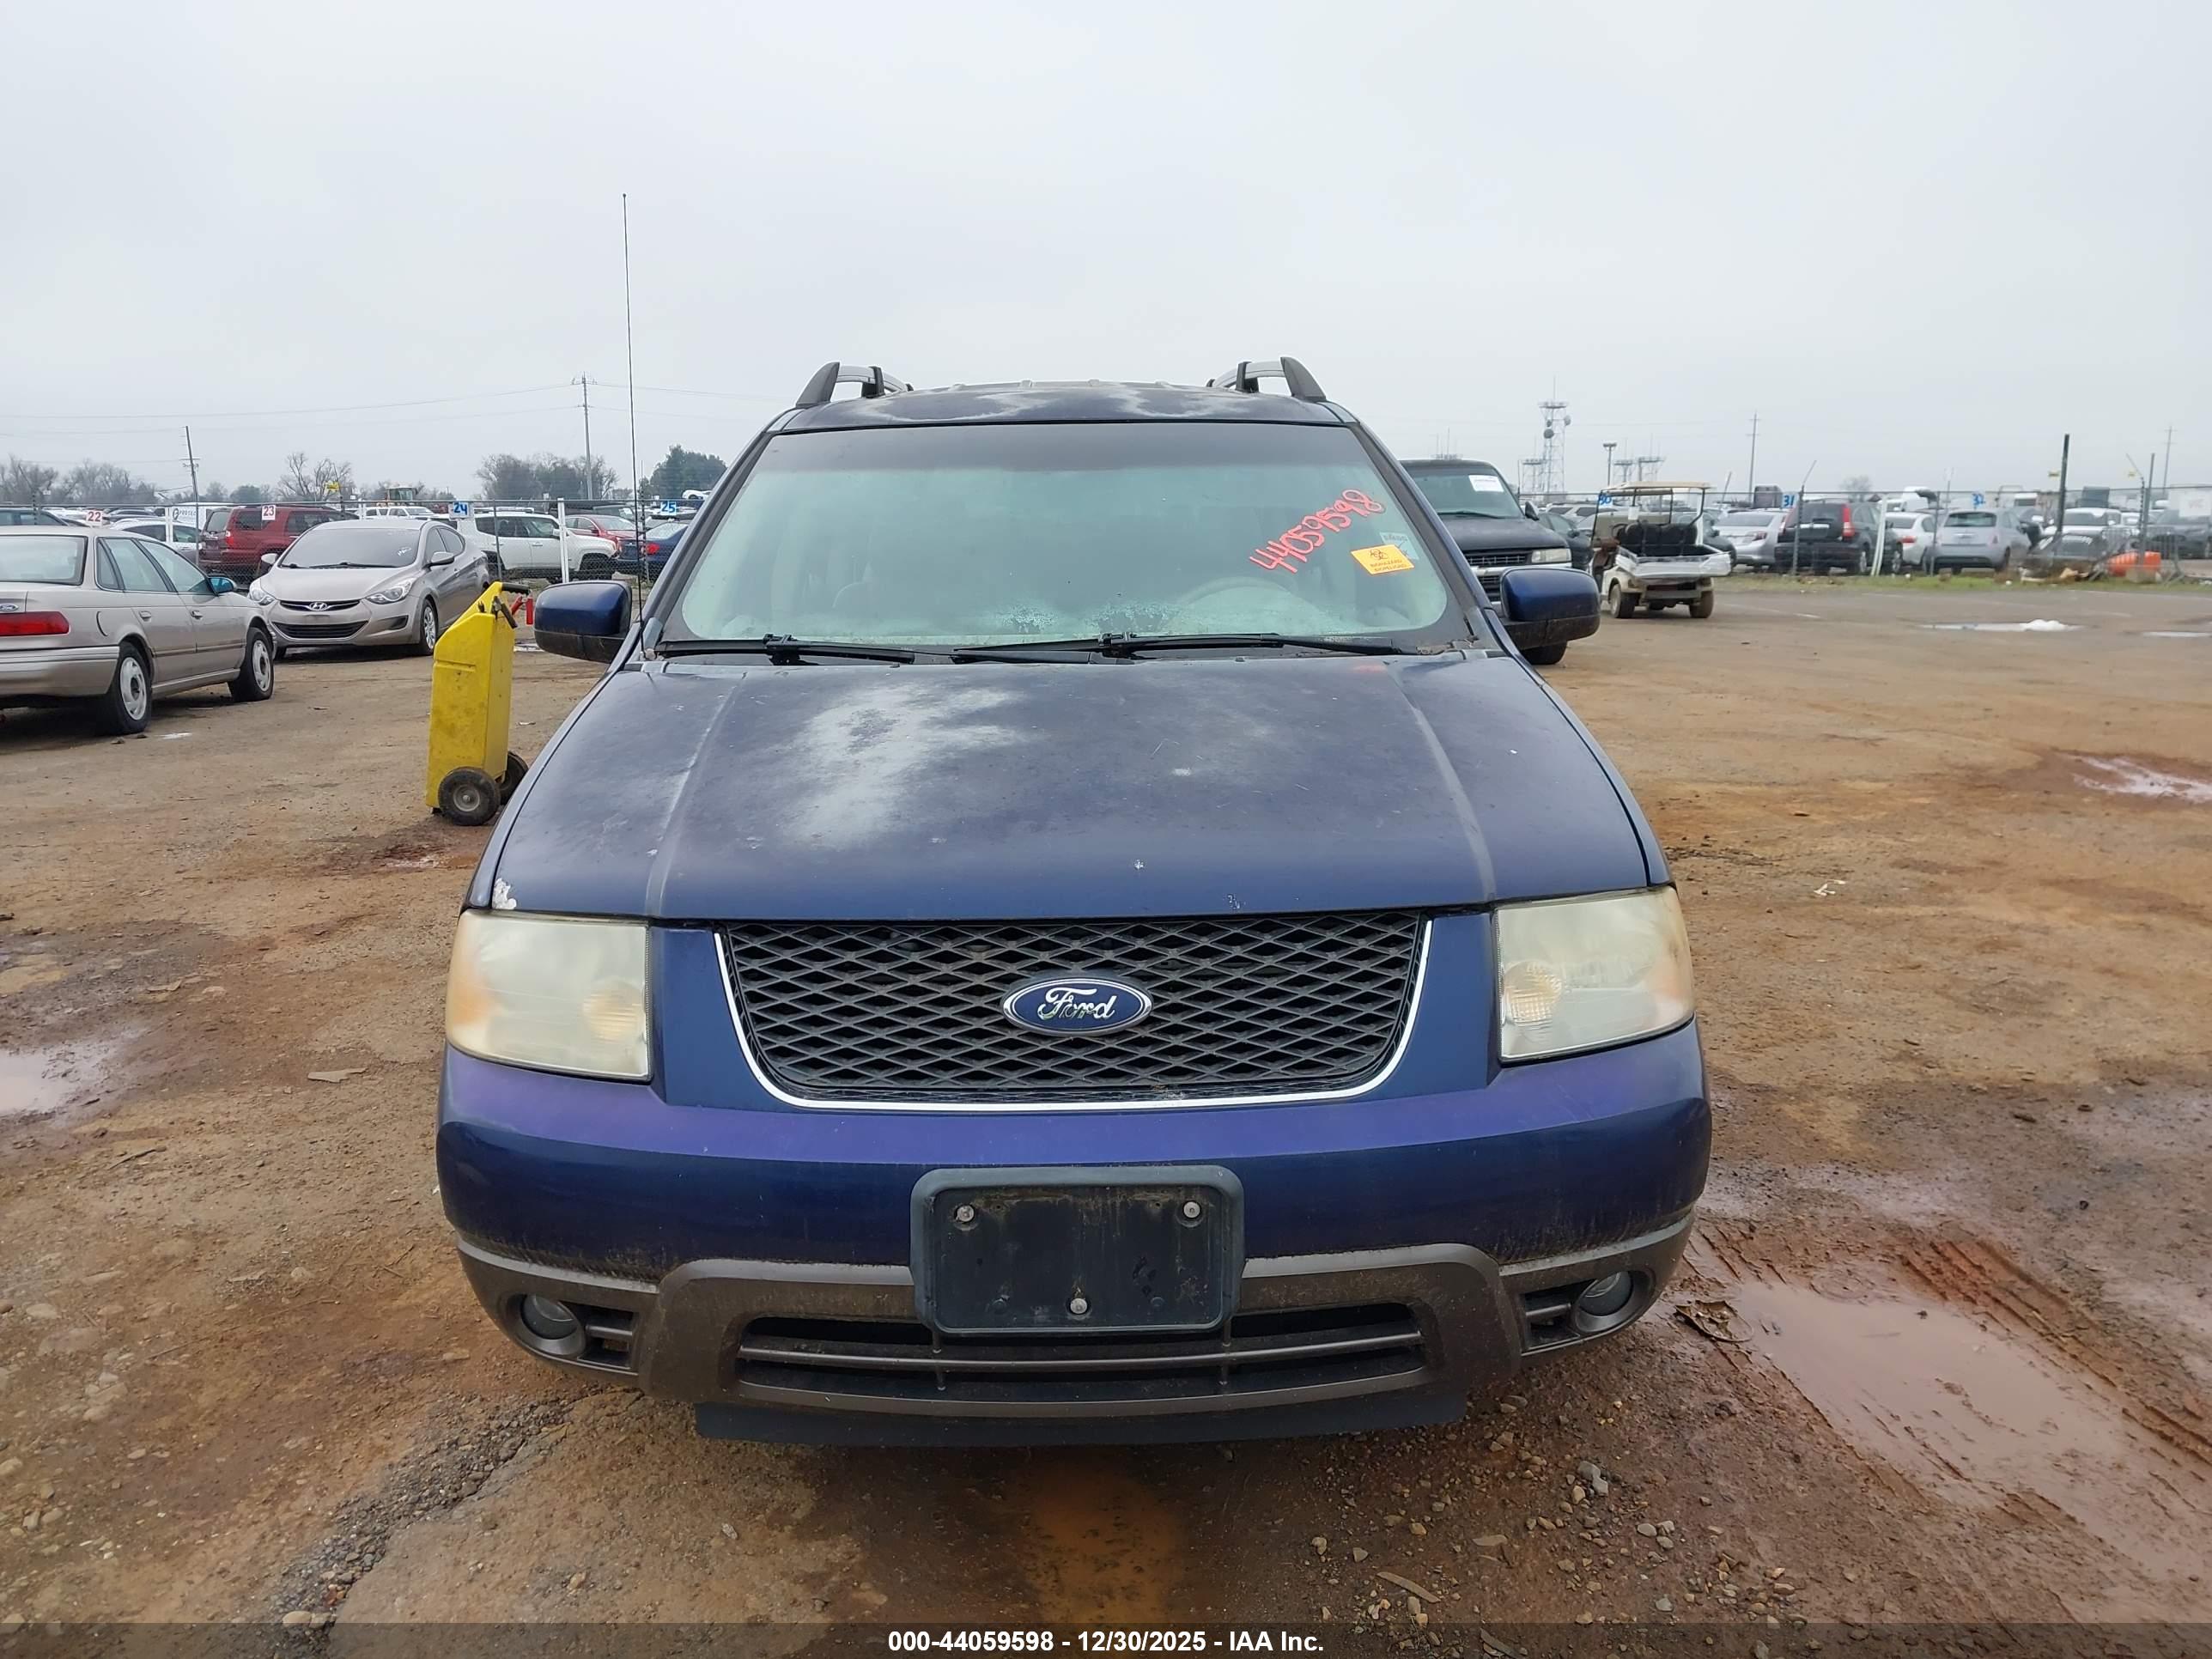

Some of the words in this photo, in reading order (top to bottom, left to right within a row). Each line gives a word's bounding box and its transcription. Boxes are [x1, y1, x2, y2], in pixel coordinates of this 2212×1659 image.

[661, 500, 676, 513] 25
[1784, 495, 1795, 507] 31
[263, 506, 275, 516] 23
[453, 502, 467, 515] 24
[88, 511, 101, 522] 22
[1249, 489, 1383, 573] 44059598
[1037, 987, 1117, 1020] Ford
